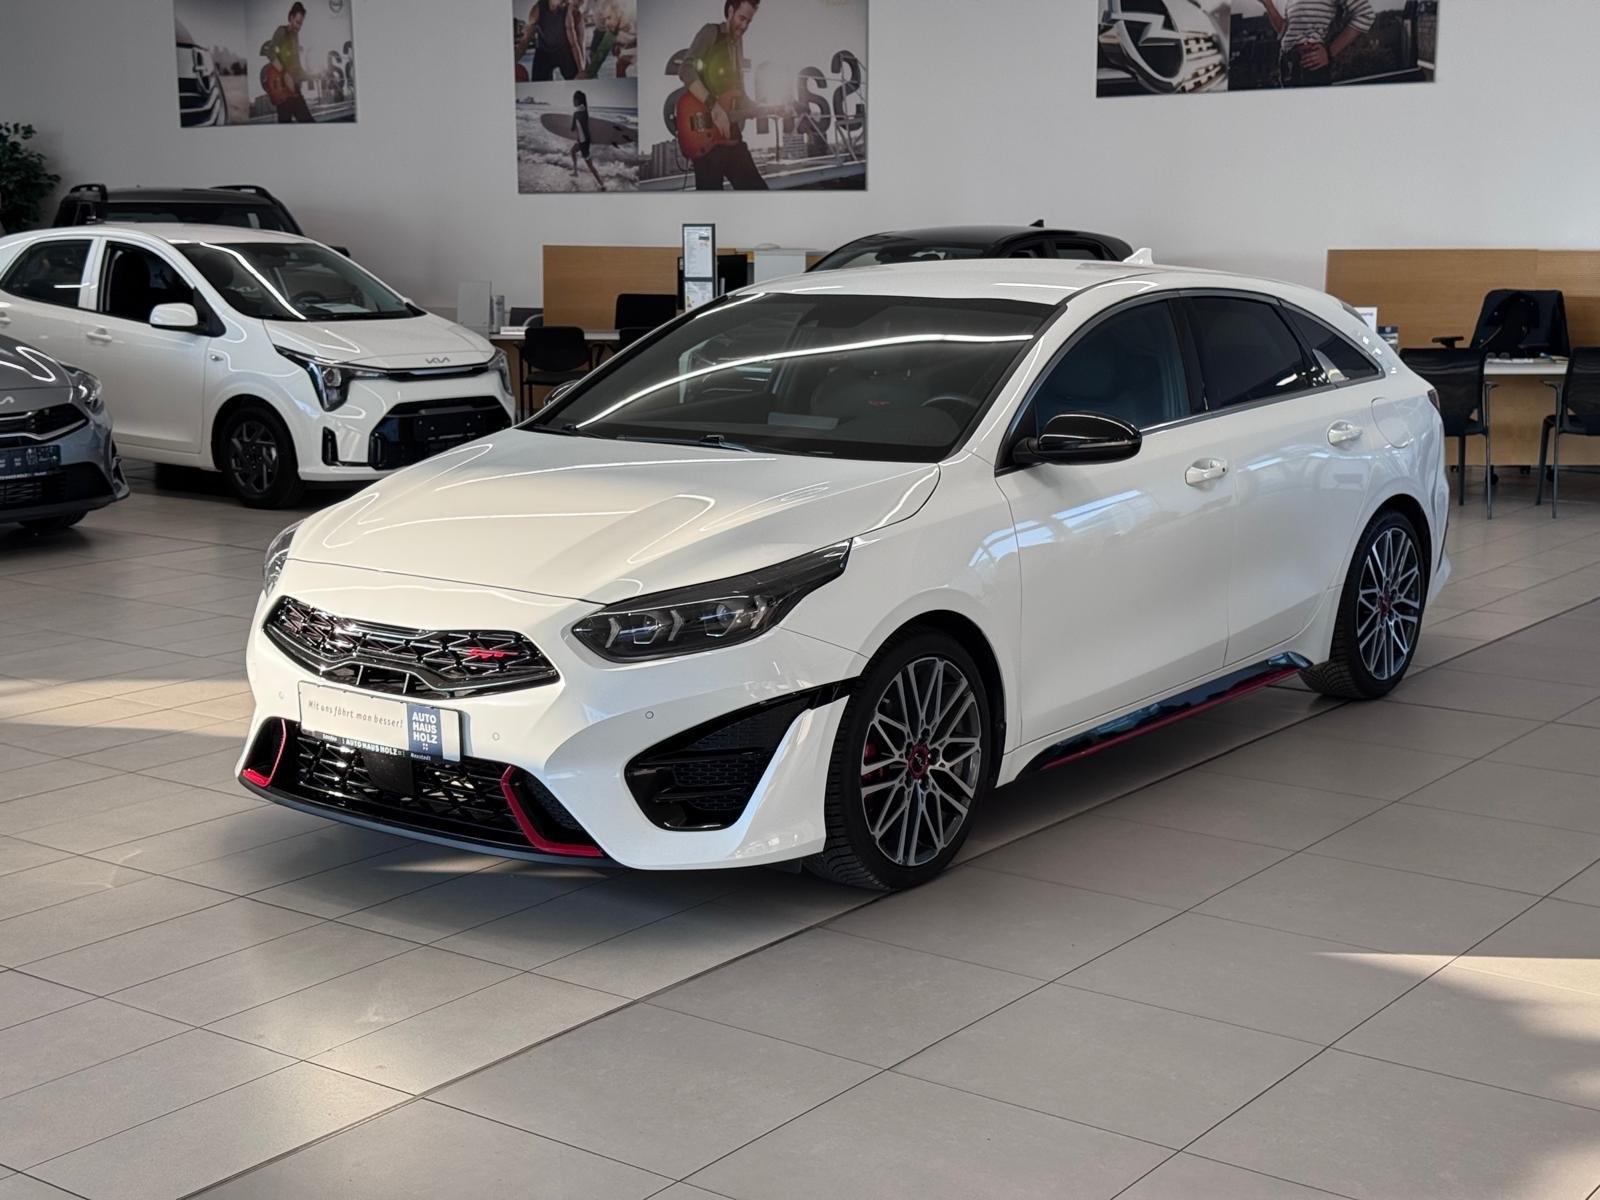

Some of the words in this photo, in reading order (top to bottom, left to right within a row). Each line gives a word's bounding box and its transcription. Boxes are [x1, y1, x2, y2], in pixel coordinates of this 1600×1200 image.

[308, 699, 319, 711] Mit
[321, 705, 332, 714] uns
[333, 705, 354, 719] führt
[355, 712, 372, 722] man
[374, 714, 403, 728] besser!
[412, 711, 437, 724] AUTO
[413, 721, 437, 734] HAUS
[413, 731, 438, 744] HOLZ
[380, 745, 398, 756] HOLZ
